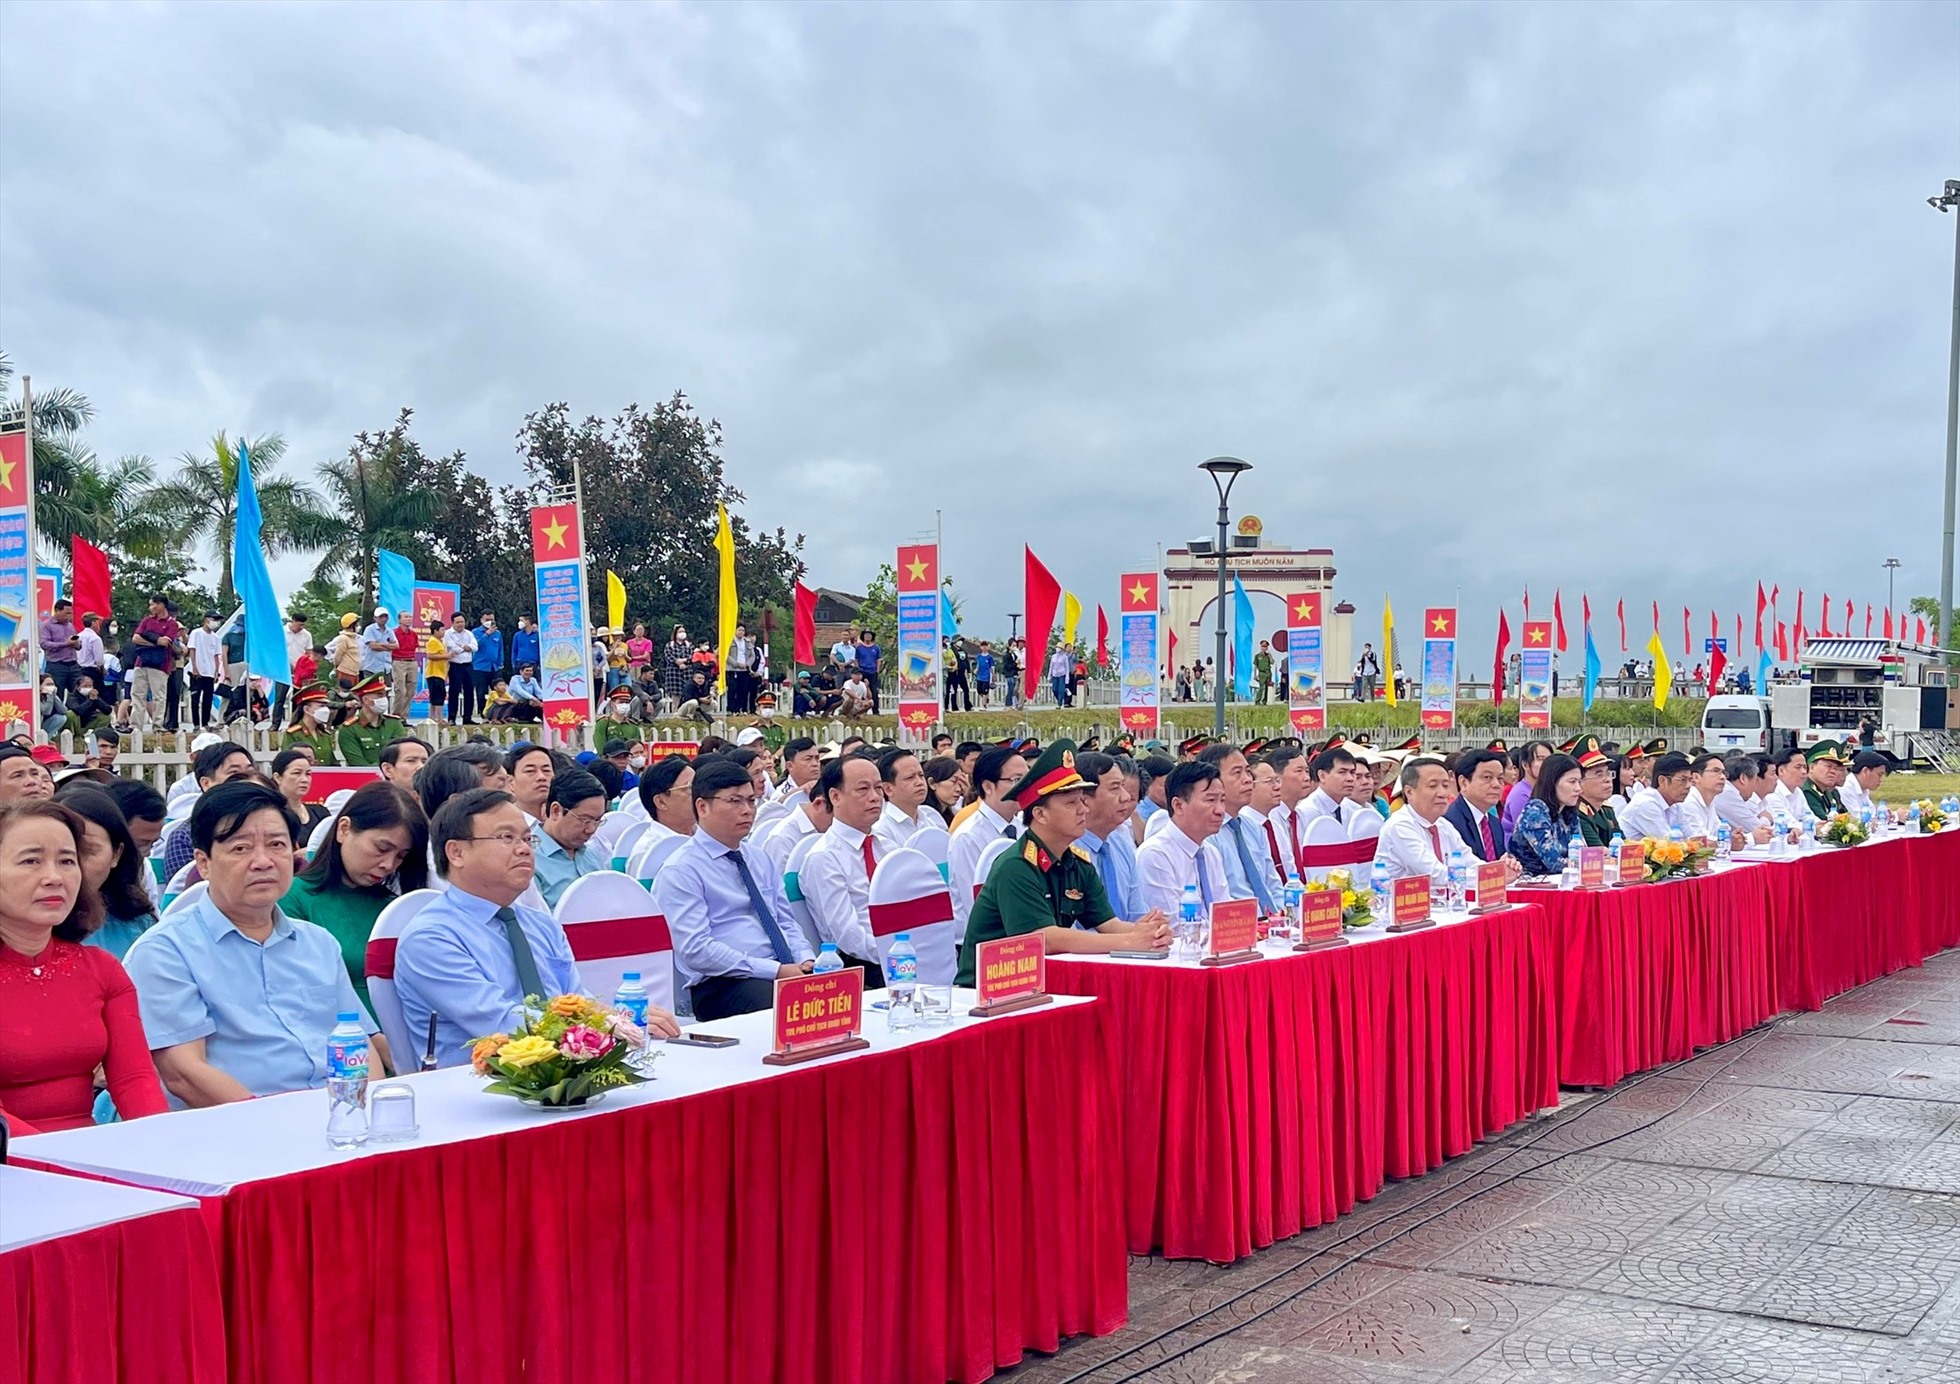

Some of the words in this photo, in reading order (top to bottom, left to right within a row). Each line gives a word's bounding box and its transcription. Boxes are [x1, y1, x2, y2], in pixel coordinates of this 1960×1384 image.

[1252, 557, 1275, 566] MUÔN
[986, 959, 1016, 981] HOÀNG
[1017, 955, 1038, 974] NAM
[786, 1000, 800, 1023] LÊ
[802, 996, 825, 1020] ĐỨC
[828, 990, 852, 1015] TIẾN
